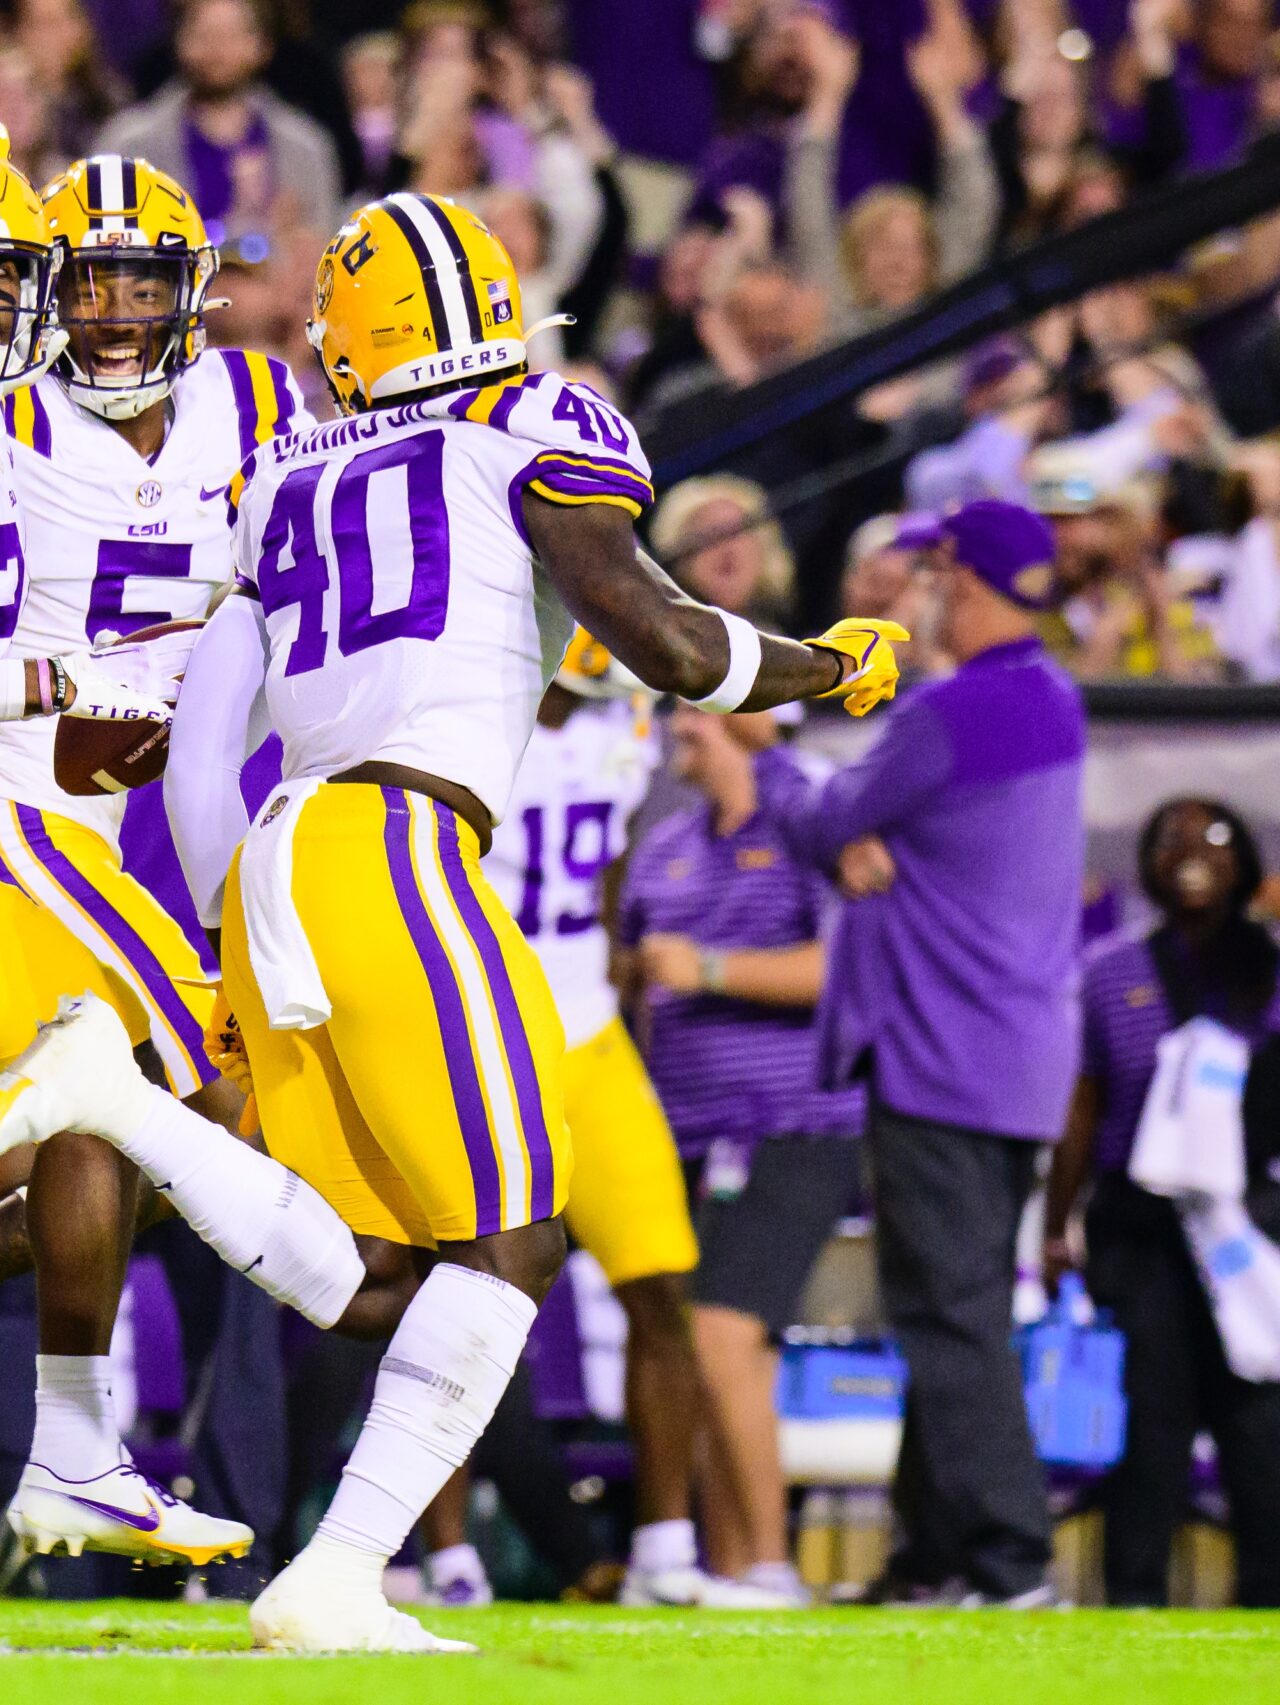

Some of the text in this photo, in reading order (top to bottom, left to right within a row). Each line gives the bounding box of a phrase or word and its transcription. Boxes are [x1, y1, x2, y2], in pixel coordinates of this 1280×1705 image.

[96, 232, 132, 245] LSU
[422, 326, 432, 341] 4
[409, 347, 508, 382] TIGERS
[551, 386, 630, 456] 40
[127, 521, 167, 537] LSU
[257, 428, 451, 678] 40
[85, 539, 194, 647] 5
[517, 802, 613, 935] 19
